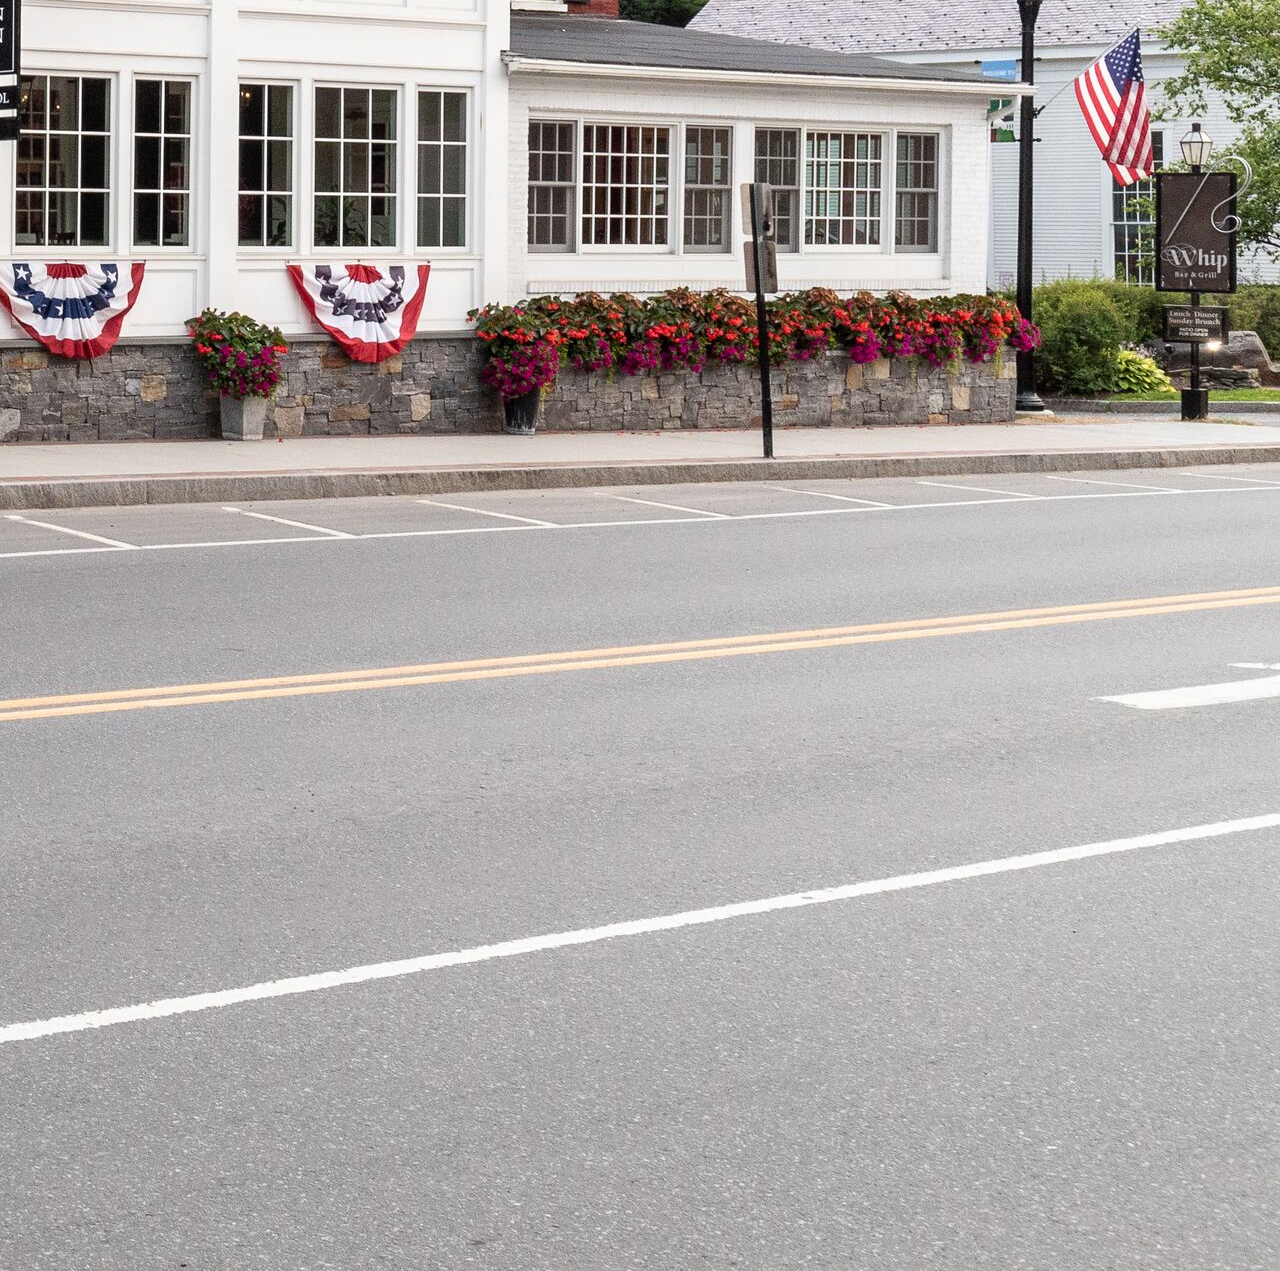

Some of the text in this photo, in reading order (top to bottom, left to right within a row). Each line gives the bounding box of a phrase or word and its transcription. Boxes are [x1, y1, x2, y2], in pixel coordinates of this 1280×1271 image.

[1165, 245, 1228, 274] Whip
[1198, 271, 1217, 279] Grill
[1168, 317, 1193, 325] Sunday
